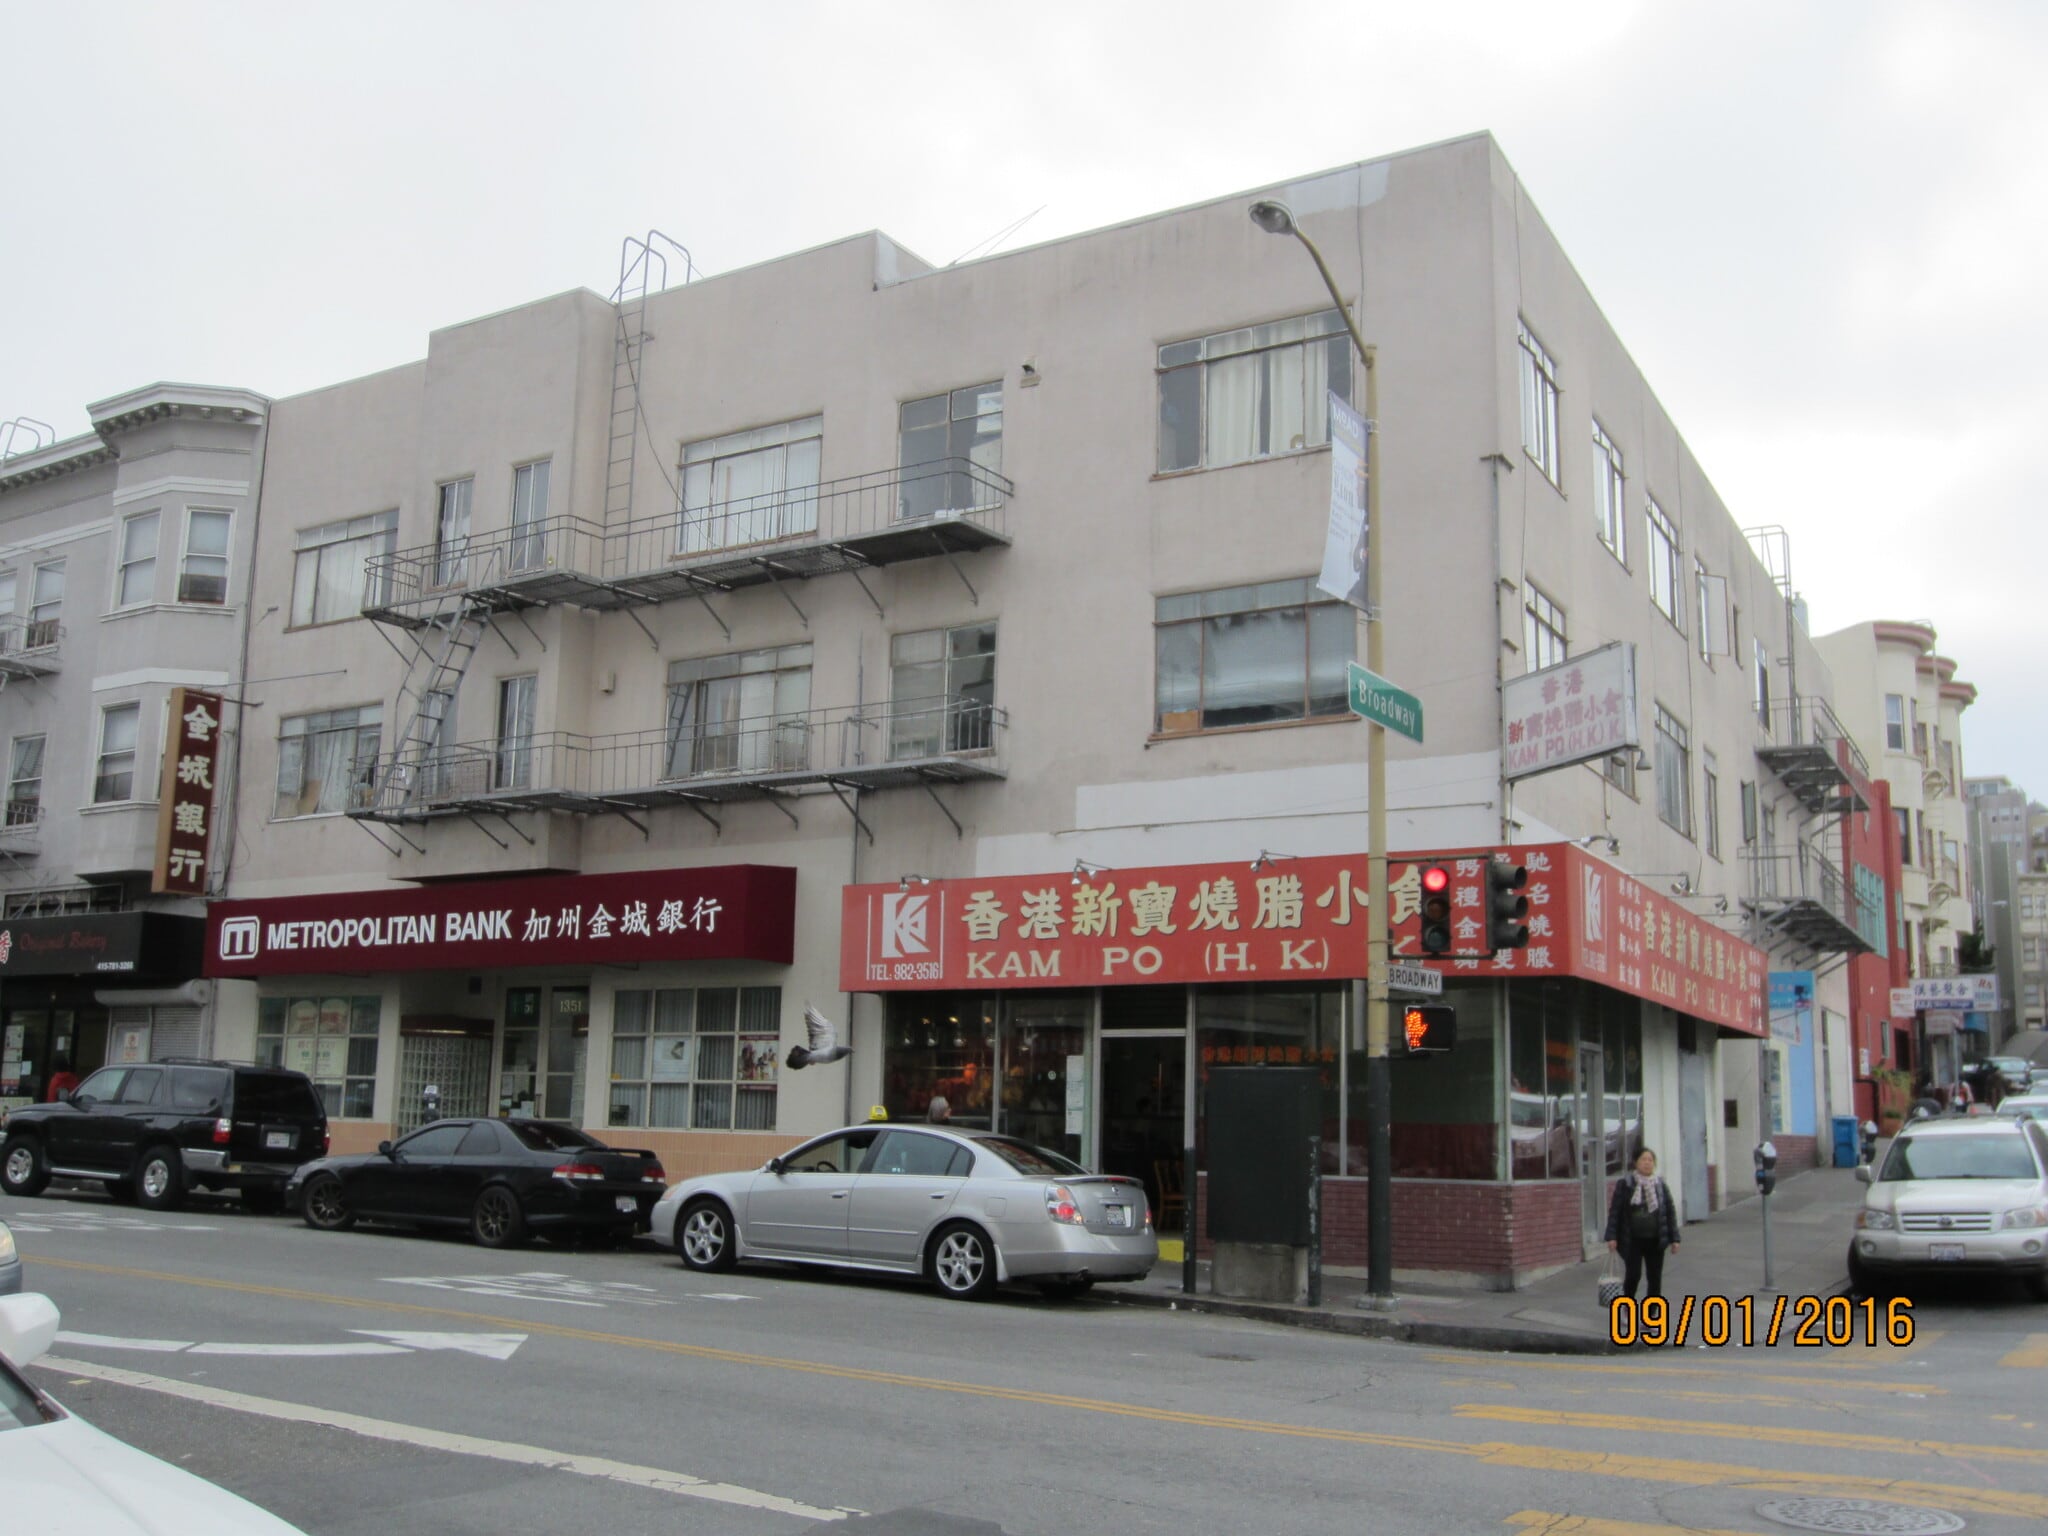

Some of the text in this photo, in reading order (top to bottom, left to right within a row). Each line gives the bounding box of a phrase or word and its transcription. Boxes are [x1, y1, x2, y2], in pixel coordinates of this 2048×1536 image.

[1359, 682, 1416, 734] Broadway
[1508, 743, 1538, 769] KAM
[1545, 735, 1565, 760] PO
[170, 703, 218, 883] 金城銀行
[267, 910, 512, 950] METROPOLITAN BANK
[522, 896, 723, 943] 加州金城銀行
[966, 948, 1062, 979] KAM
[1102, 945, 1163, 976] PO
[1389, 968, 1439, 990] BROADWAY
[1651, 963, 1677, 999] KAM
[1684, 977, 1699, 1007] PO
